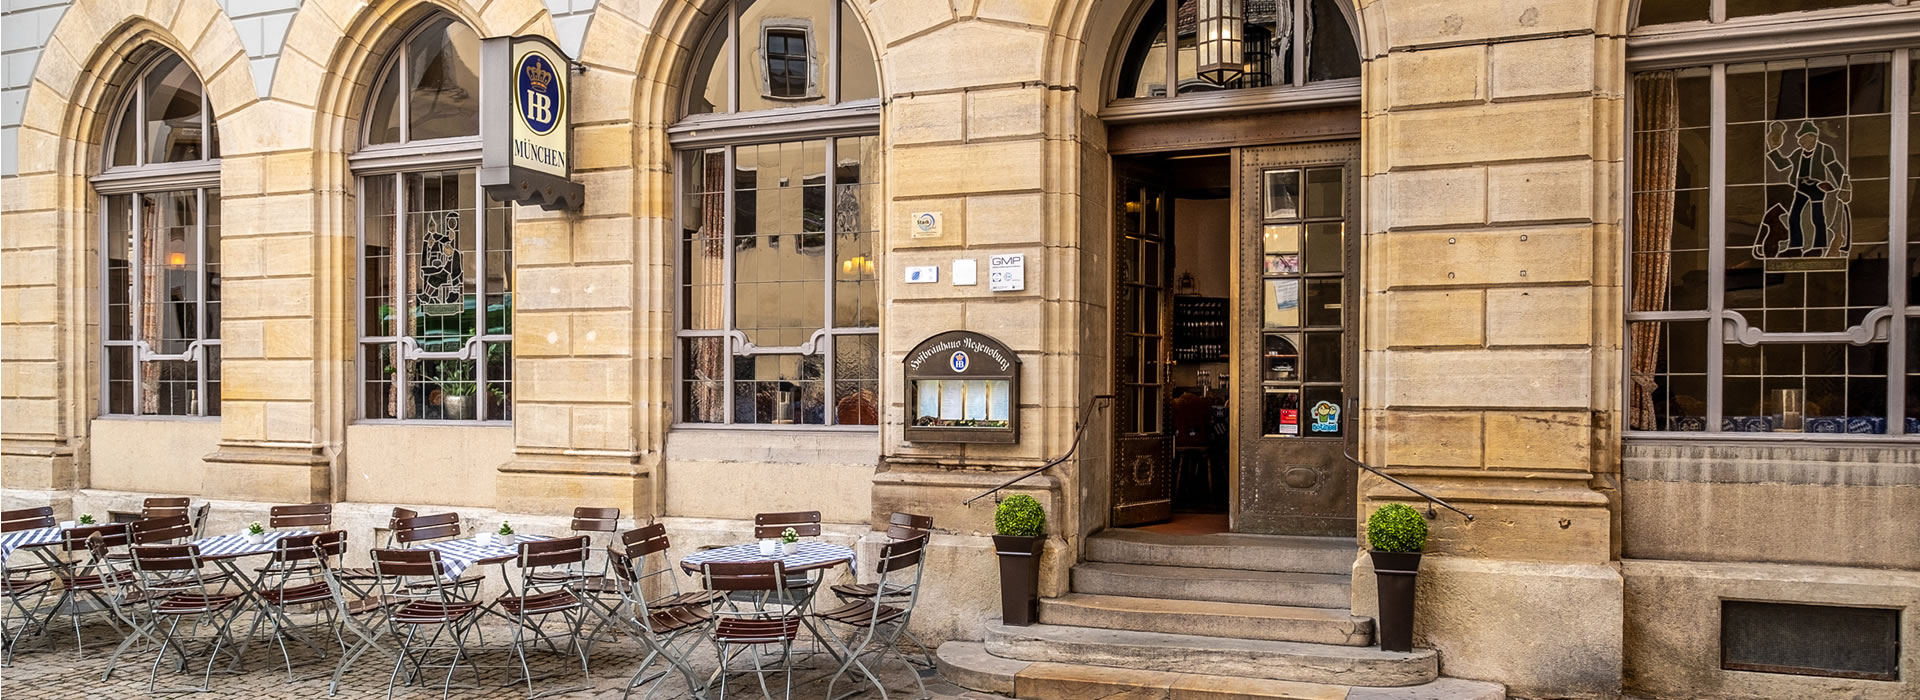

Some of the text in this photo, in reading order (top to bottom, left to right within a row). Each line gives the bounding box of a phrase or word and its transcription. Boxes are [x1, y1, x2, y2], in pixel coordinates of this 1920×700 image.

[527, 89, 552, 124] HB
[515, 139, 565, 167] MÜNCHEN
[992, 257, 1021, 266] GMP
[910, 337, 1010, 372] Hofbräuhaus Regensburg
